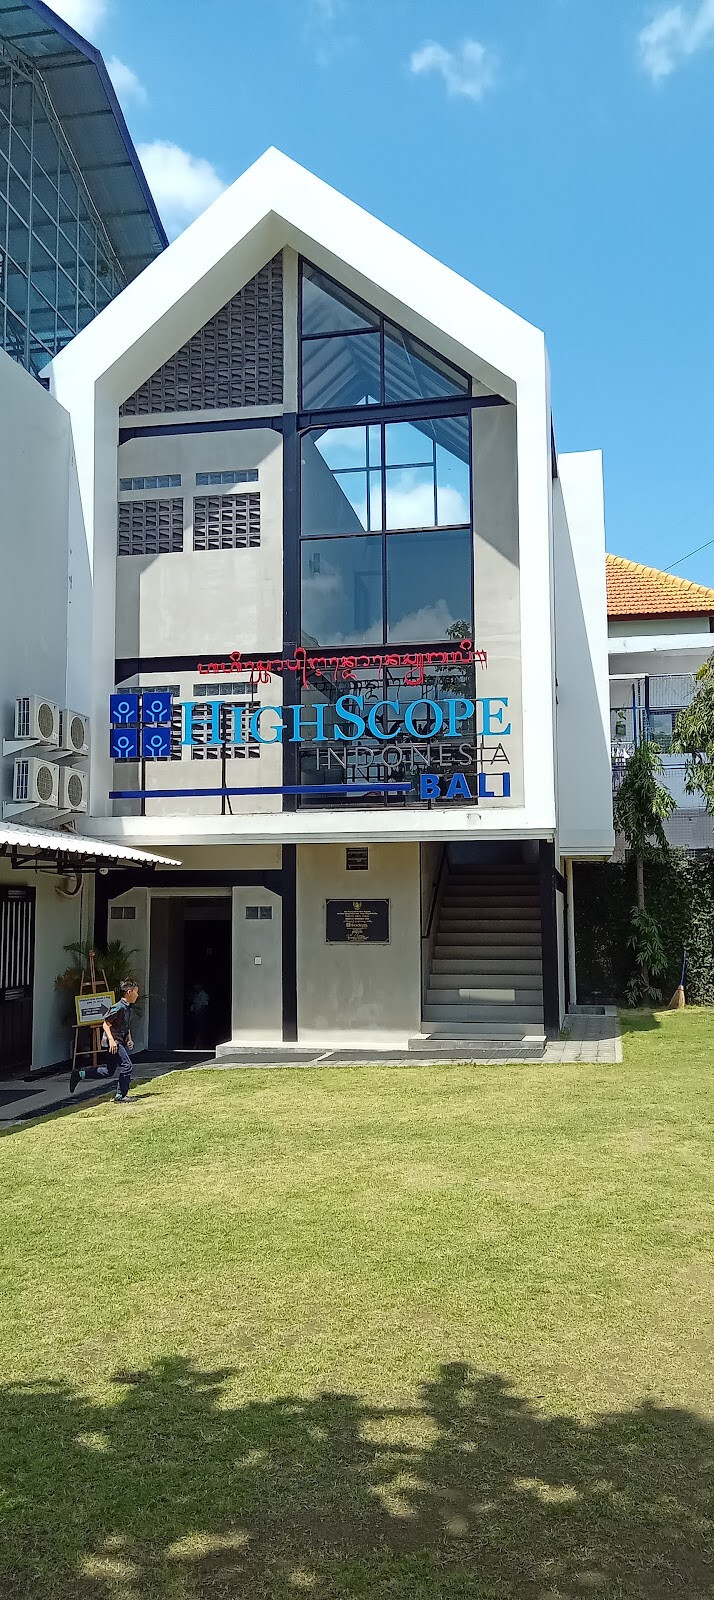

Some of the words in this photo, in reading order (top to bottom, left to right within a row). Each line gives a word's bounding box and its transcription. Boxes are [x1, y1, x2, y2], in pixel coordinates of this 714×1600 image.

[182, 695, 511, 745] HIGHSCOPE
[316, 743, 511, 770] INDONESIA
[420, 773, 511, 799] BALI
